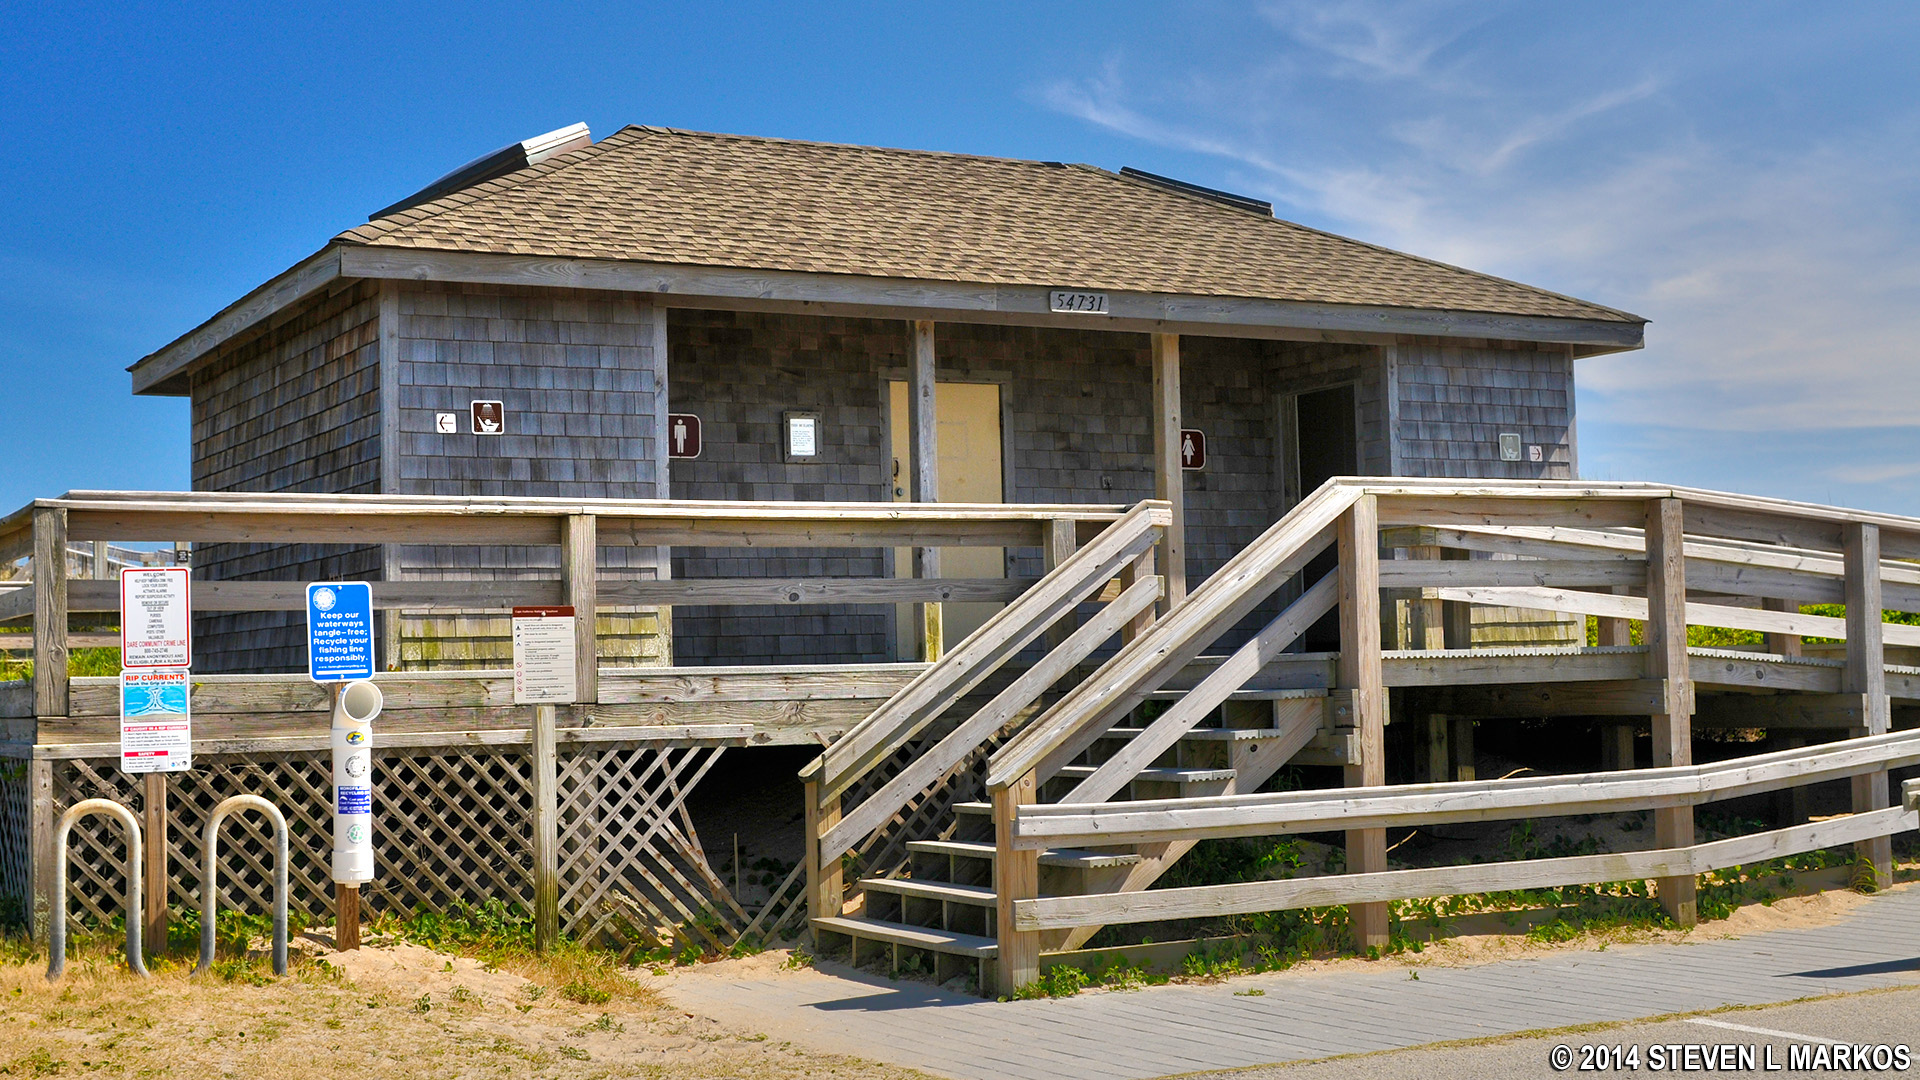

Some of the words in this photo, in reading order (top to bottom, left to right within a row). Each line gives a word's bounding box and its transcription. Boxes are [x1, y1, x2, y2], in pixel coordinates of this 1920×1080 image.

[1058, 294, 1103, 311] 54731
[314, 638, 348, 646] Recycle
[349, 638, 368, 646] your
[319, 646, 348, 654] fishing
[315, 654, 368, 664] responsibly.
